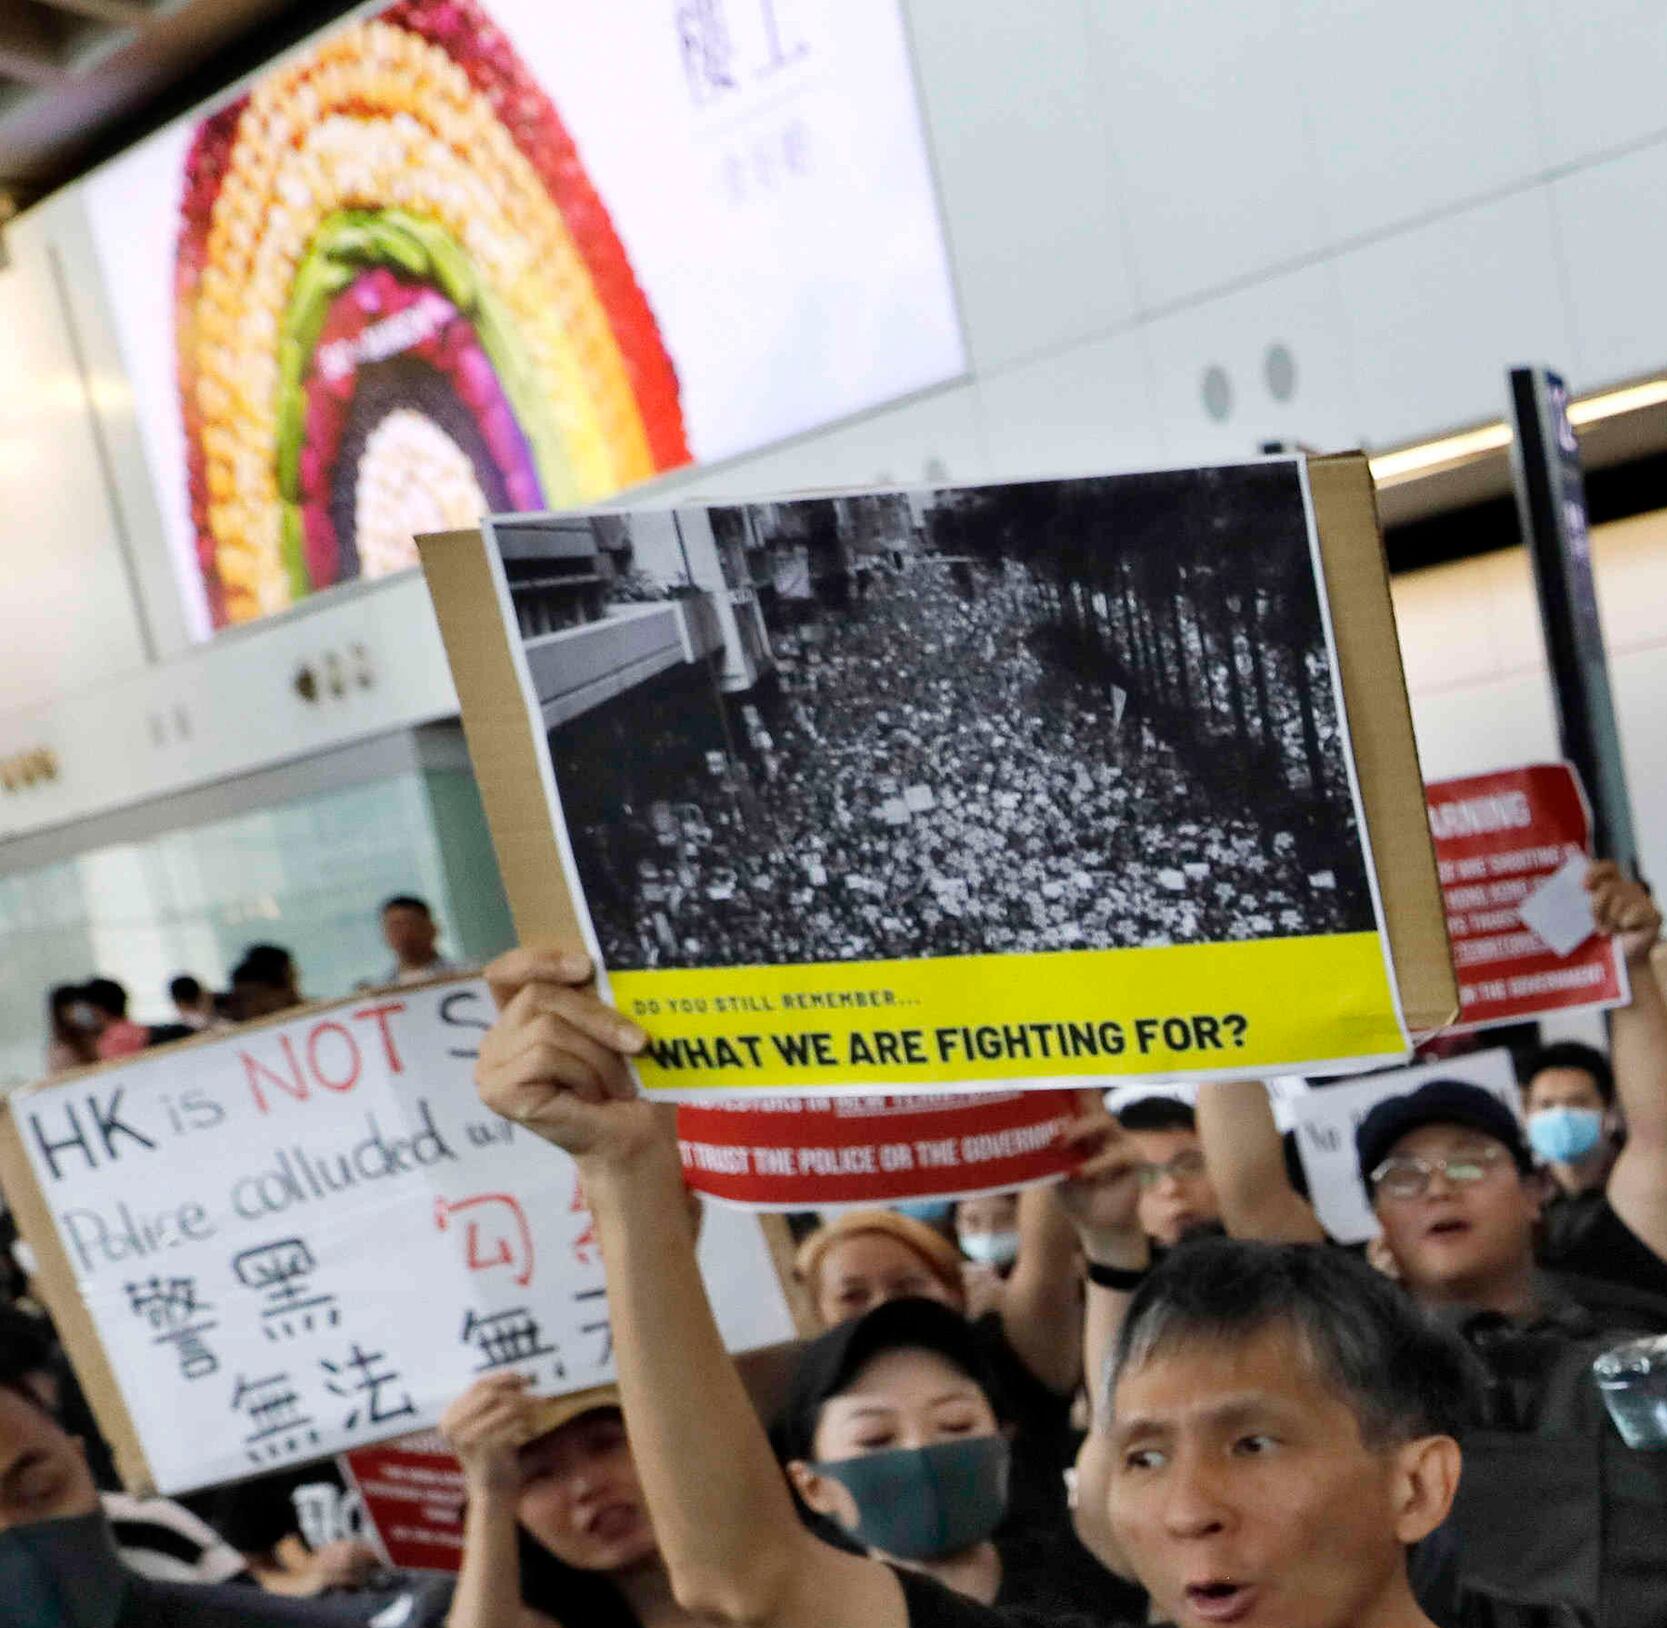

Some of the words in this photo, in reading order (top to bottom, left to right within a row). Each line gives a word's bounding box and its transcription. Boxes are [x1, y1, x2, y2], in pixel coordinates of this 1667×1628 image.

[633, 998, 661, 1017] DO
[668, 998, 709, 1015] YOU
[714, 996, 774, 1013] STILL
[647, 1034, 763, 1070] WHAT
[771, 1031, 838, 1067] WE
[848, 1029, 929, 1065] ARE
[935, 1021, 1127, 1063] FIGHTING
[1134, 1013, 1249, 1055] FOR?
[30, 1086, 156, 1180] HK
[239, 1001, 407, 1113] NOT
[230, 1097, 458, 1220] colluded
[752, 1146, 797, 1176] THE
[797, 1145, 878, 1176] POLICE
[915, 1137, 960, 1167] THE
